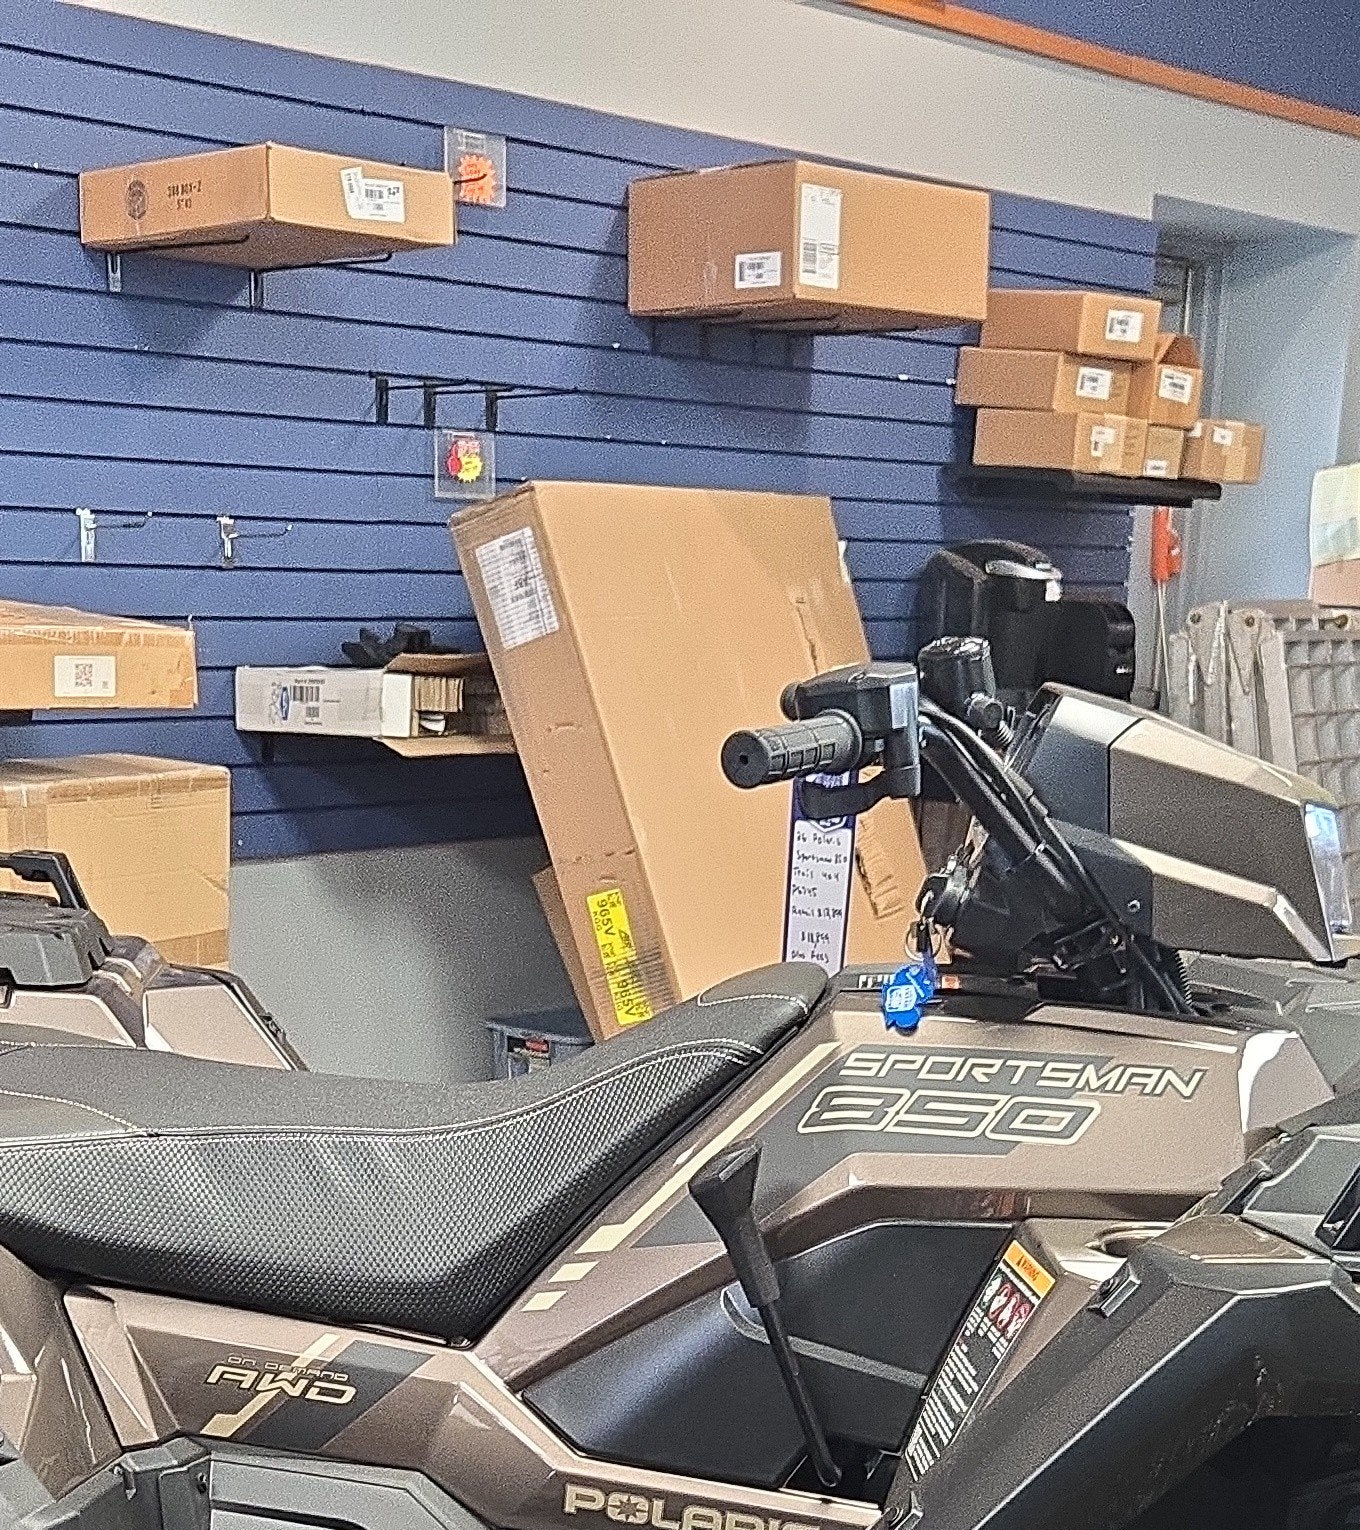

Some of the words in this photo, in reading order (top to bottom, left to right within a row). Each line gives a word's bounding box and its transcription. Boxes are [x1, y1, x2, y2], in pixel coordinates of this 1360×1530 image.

[840, 1051, 1208, 1099] SPORTSMAN
[797, 1086, 1101, 1146] 850
[205, 1364, 358, 1405] AWD
